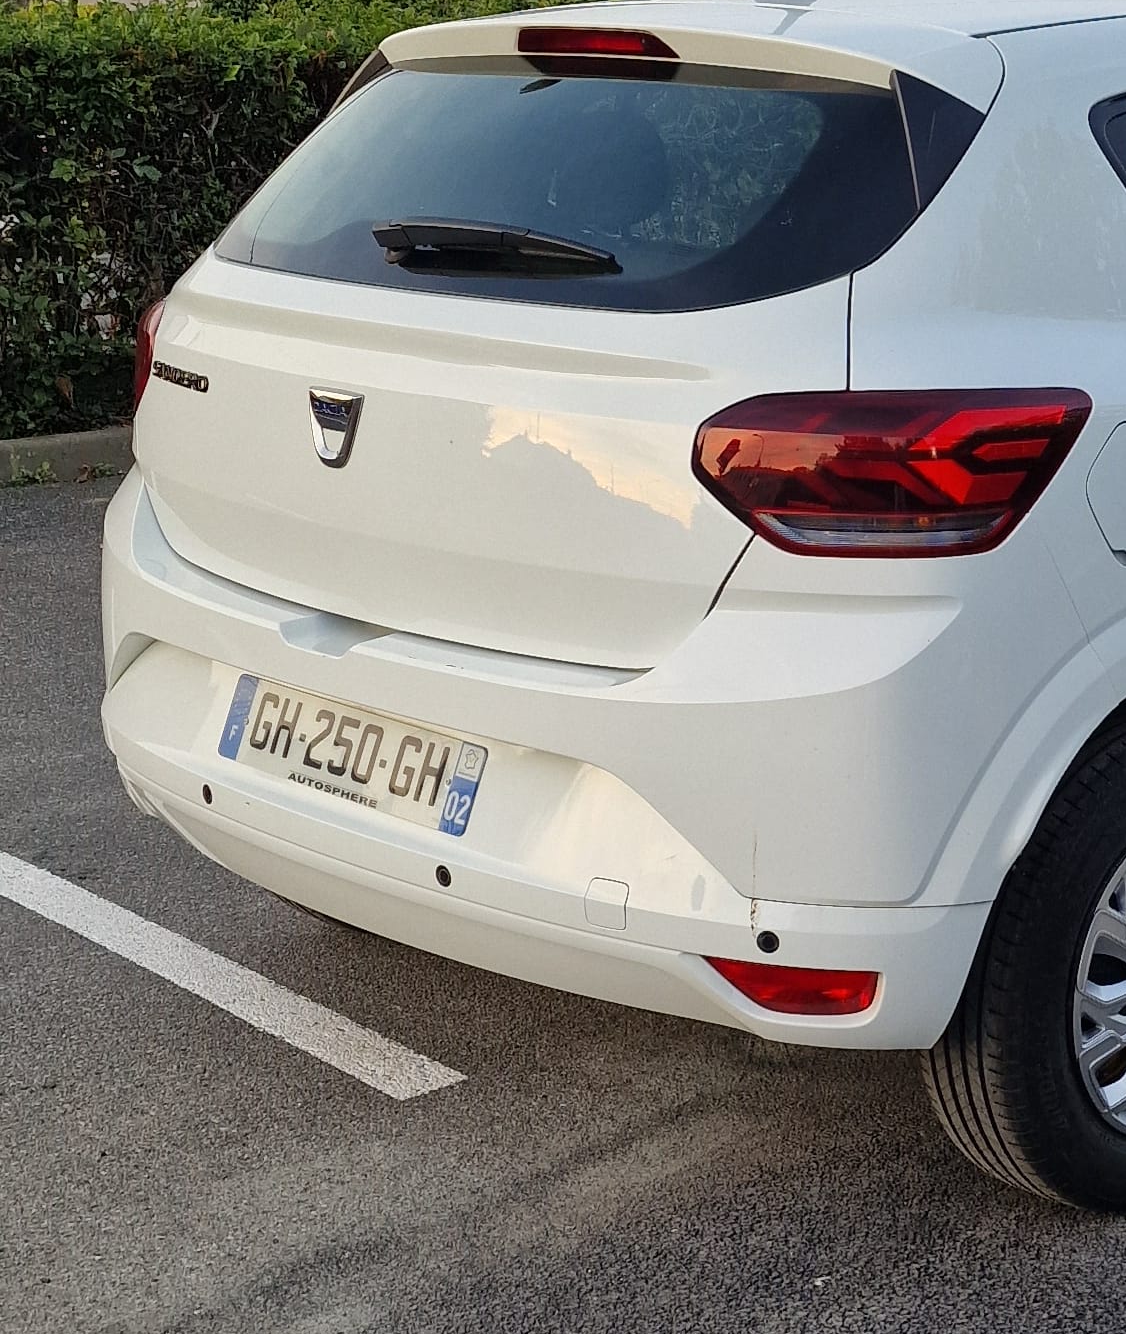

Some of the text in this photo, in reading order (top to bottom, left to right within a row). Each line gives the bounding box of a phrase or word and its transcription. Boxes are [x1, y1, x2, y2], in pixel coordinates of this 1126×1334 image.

[228, 724, 239, 741] F
[250, 692, 450, 806] GH-250-GH
[287, 772, 378, 809] AUTOSPHERE
[444, 791, 471, 825] 02
